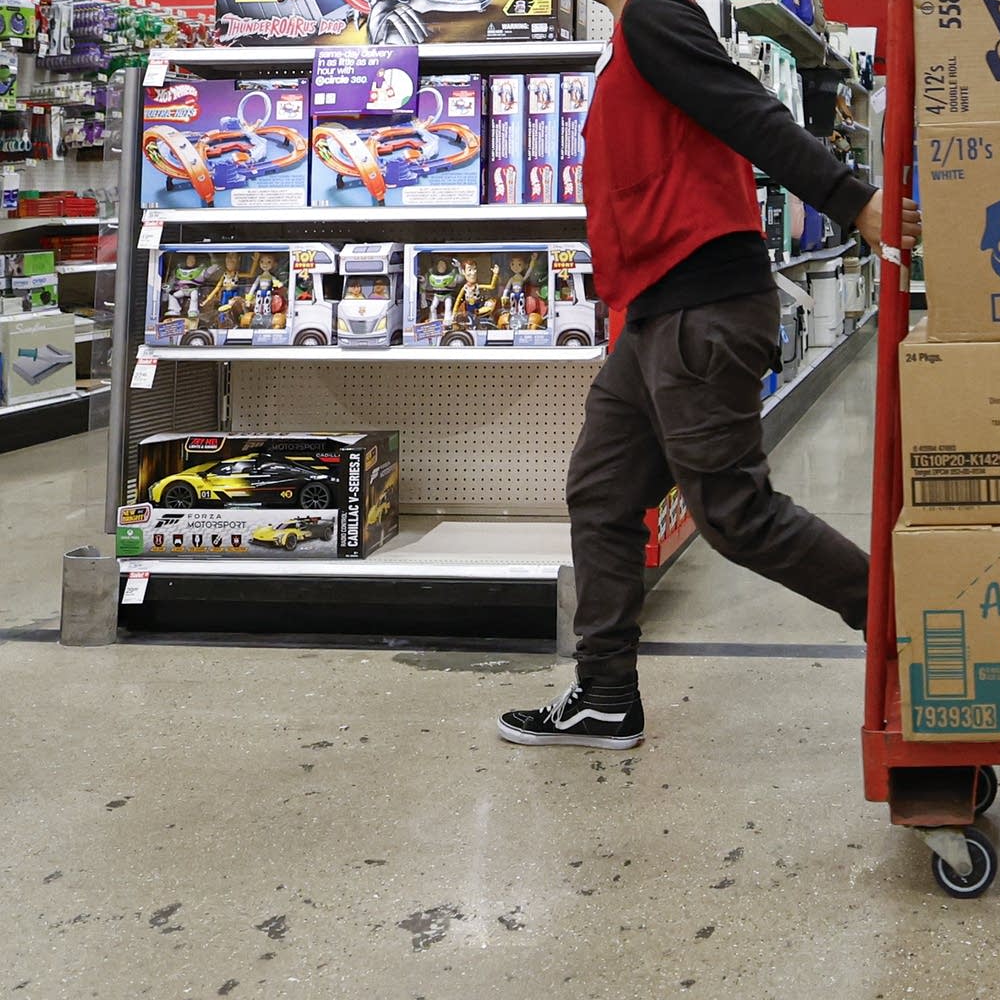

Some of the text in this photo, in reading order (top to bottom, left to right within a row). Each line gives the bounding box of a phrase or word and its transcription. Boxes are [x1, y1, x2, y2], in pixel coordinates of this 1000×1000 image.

[319, 19, 346, 36] DROP
[319, 48, 393, 59] same-day delivery
[319, 58, 325, 66] in
[339, 58, 355, 66] little
[317, 66, 354, 75] hour with
[351, 76, 367, 84] 360
[949, 56, 958, 113] DOUBLE ROLL
[923, 65, 946, 115] 4/12's
[960, 86, 969, 112] WHITE
[931, 137, 993, 167] 2/18's
[931, 169, 965, 180] WHITE
[293, 250, 316, 262] TOY
[551, 250, 576, 262] TOY
[299, 269, 309, 280] 4
[558, 268, 570, 280] 4
[906, 353, 942, 364] 24 Pkgs.
[201, 491, 211, 499] 01
[347, 453, 360, 547] CADILLAC V-SERIES.R
